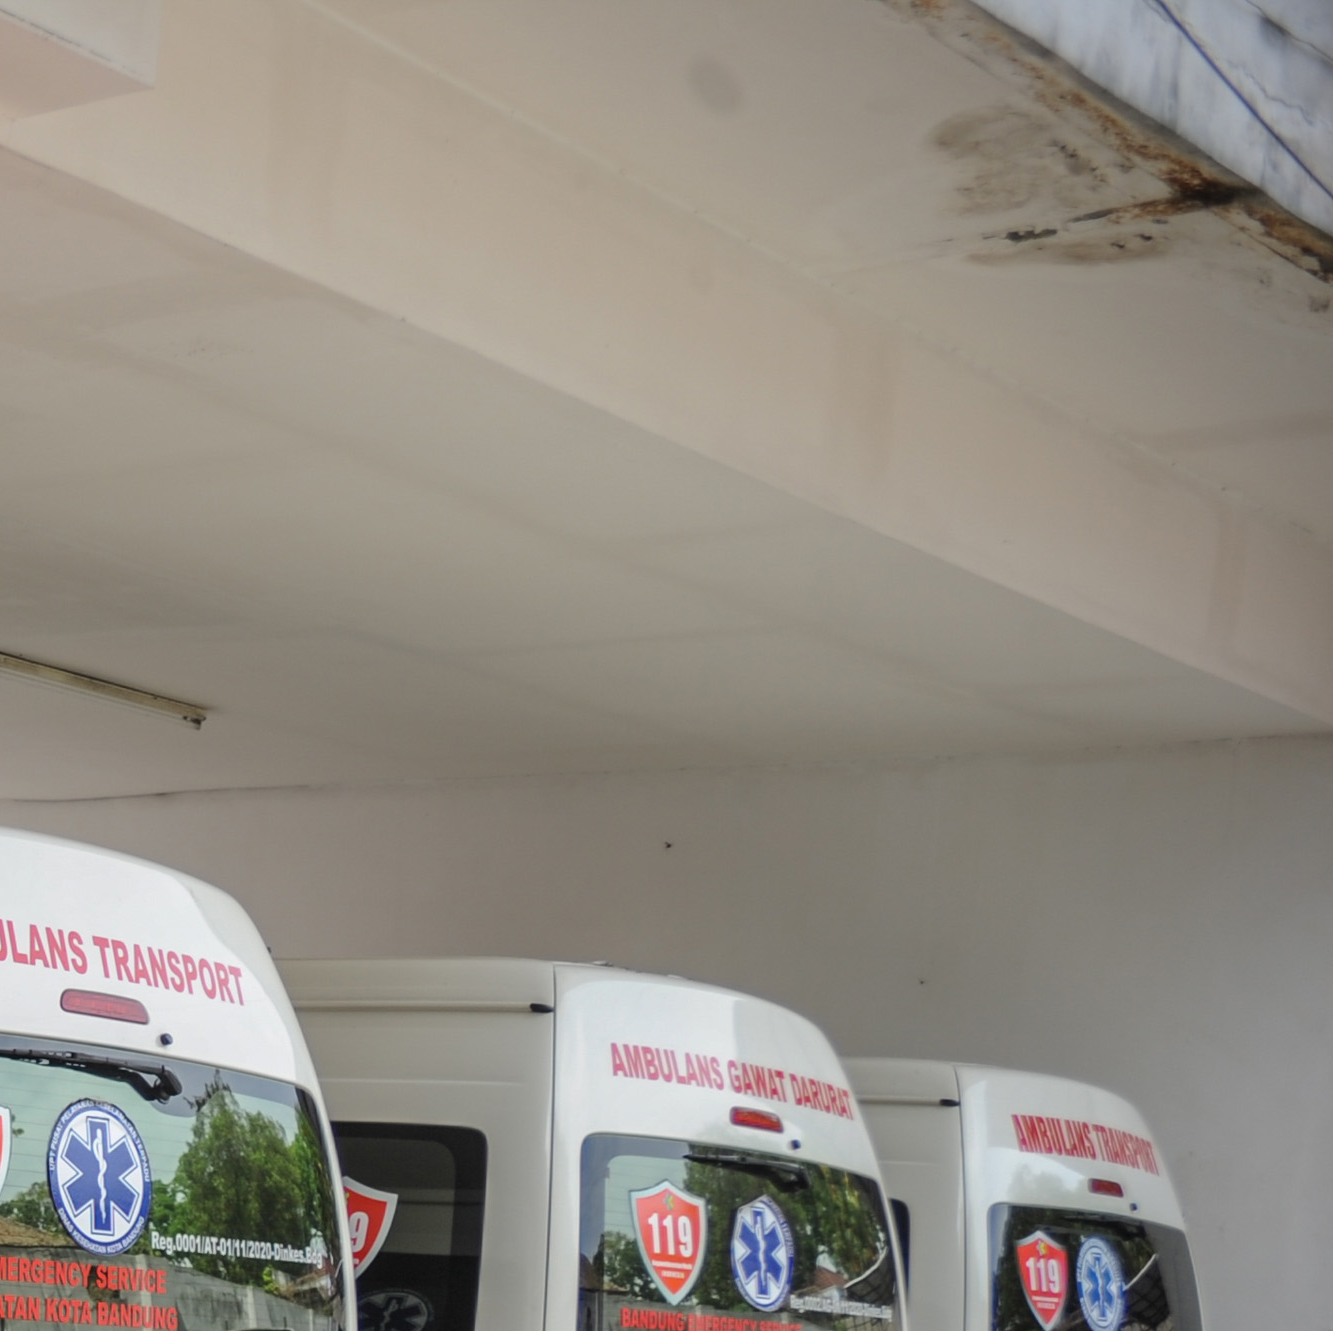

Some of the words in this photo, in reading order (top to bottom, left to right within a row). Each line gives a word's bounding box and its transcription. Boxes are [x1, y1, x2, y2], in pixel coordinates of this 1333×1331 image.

[92, 934, 245, 1006] TRANSPORT
[610, 1042, 725, 1091] AMBULANS
[726, 1059, 788, 1103] GAWAT
[788, 1072, 855, 1120] DARURAT
[1010, 1113, 1097, 1161] AMBULANS
[1091, 1123, 1160, 1177] TRANSPORT
[647, 1212, 694, 1258] 119
[95, 1266, 167, 1295] SERVICE
[1025, 1256, 1061, 1294] 119
[45, 1297, 92, 1326] KOTA
[97, 1302, 179, 1331] BANDUNG
[619, 1306, 685, 1331] BANDUNG
